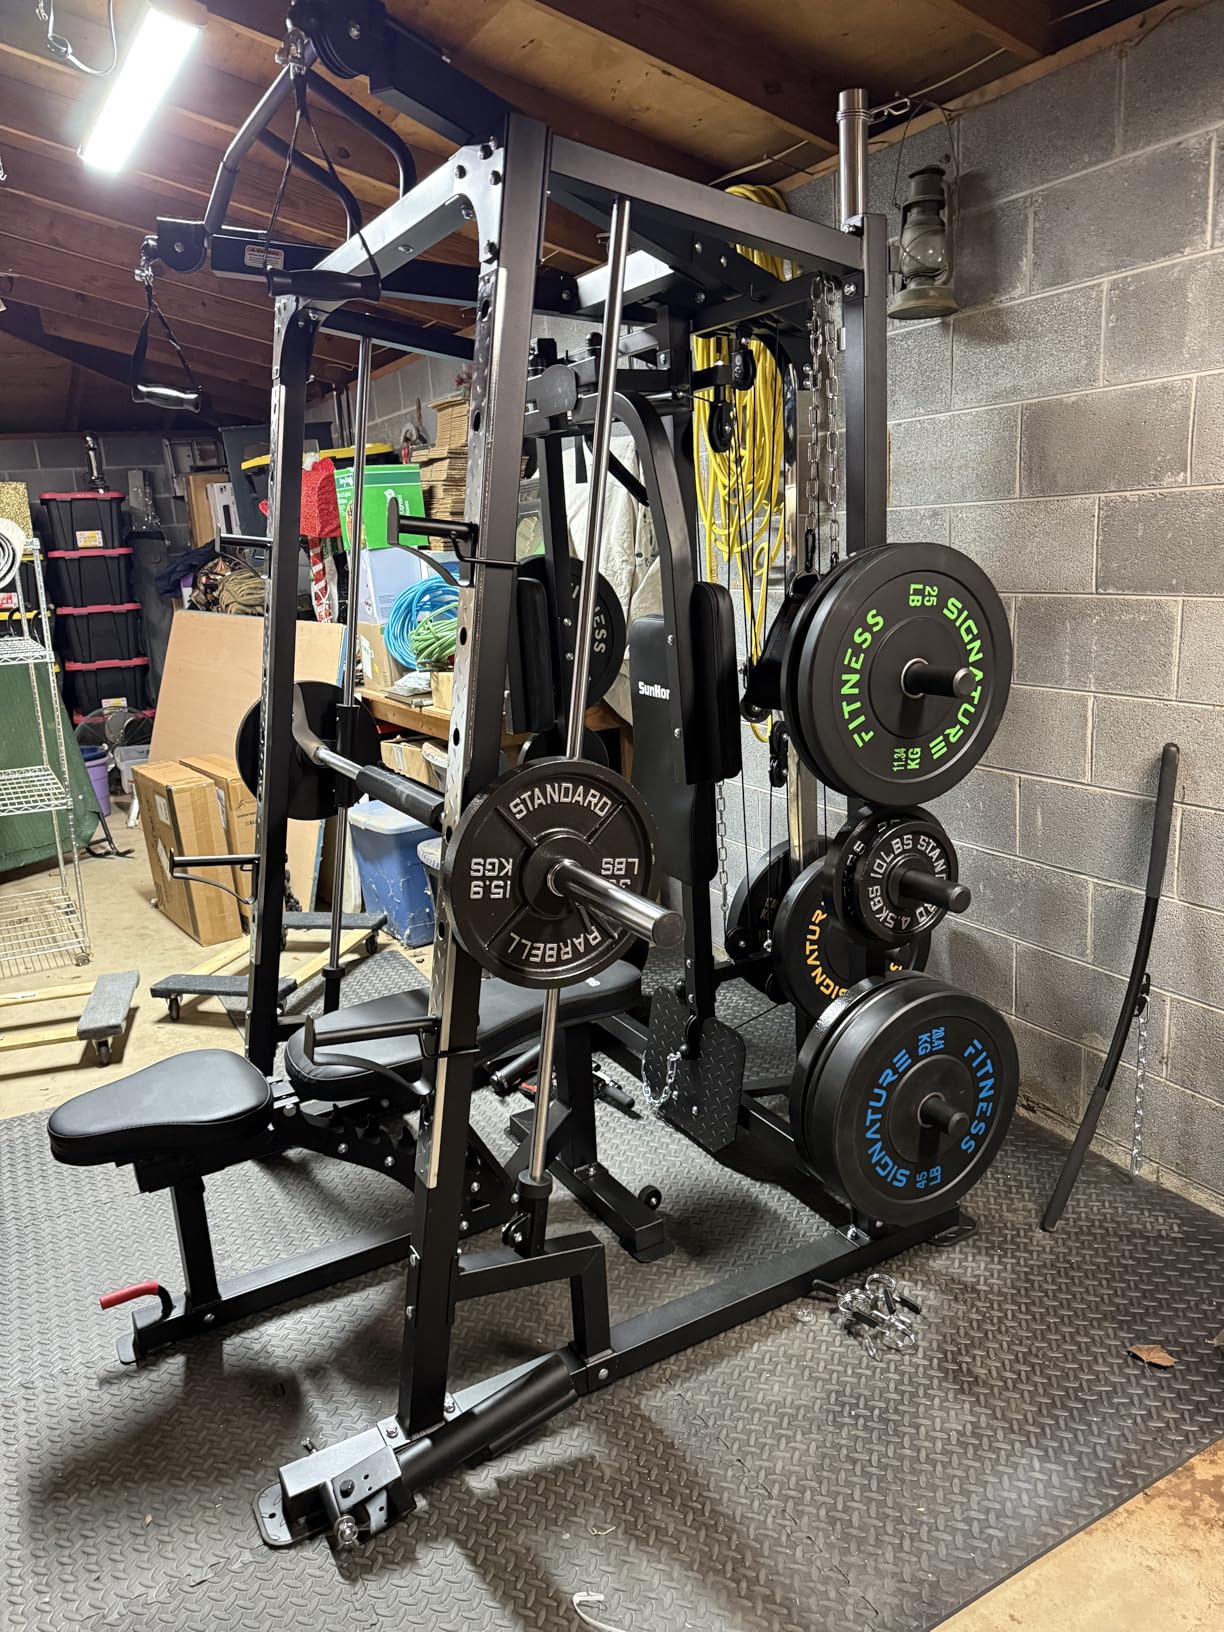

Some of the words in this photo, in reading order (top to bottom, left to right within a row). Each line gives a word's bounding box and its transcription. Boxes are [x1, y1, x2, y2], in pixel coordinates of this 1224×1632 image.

[909, 583, 923, 607] LB
[923, 585, 938, 607] 25
[840, 609, 885, 748] FITNESS
[929, 597, 984, 760] SIGNATURE
[892, 748, 907, 771] 11.34
[907, 747, 921, 770] KG
[509, 783, 612, 820] STANDARD
[470, 858, 513, 876] KGS
[600, 858, 639, 875] LBS
[870, 835, 913, 879] 10LBS
[469, 880, 511, 900] 15.9
[867, 885, 911, 930] 4.5KGS
[507, 925, 602, 963] BARBELL
[805, 901, 849, 1000] SIGNATUR
[918, 1032, 931, 1056] KG
[932, 1026, 945, 1052] 20.41
[961, 1039, 997, 1154] FITNESS
[865, 1048, 912, 1188] SIGNATURE
[915, 1171, 927, 1189] 45
[929, 1165, 942, 1186] LB
